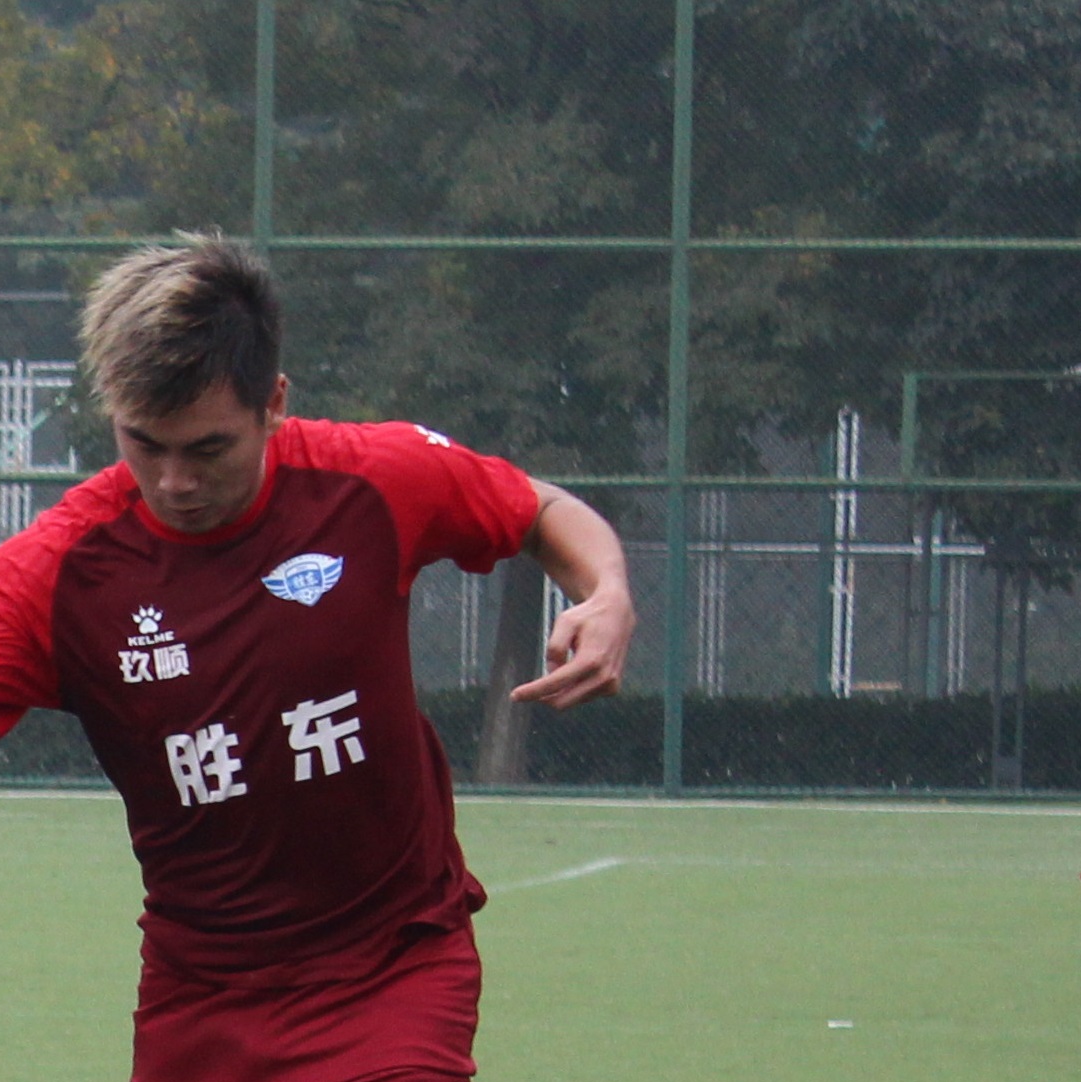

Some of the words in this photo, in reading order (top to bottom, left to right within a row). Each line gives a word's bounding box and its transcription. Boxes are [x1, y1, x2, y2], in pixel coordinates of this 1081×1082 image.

[128, 631, 175, 646] KELME
[118, 643, 190, 683] 玖顺
[165, 690, 366, 806] 胜东
